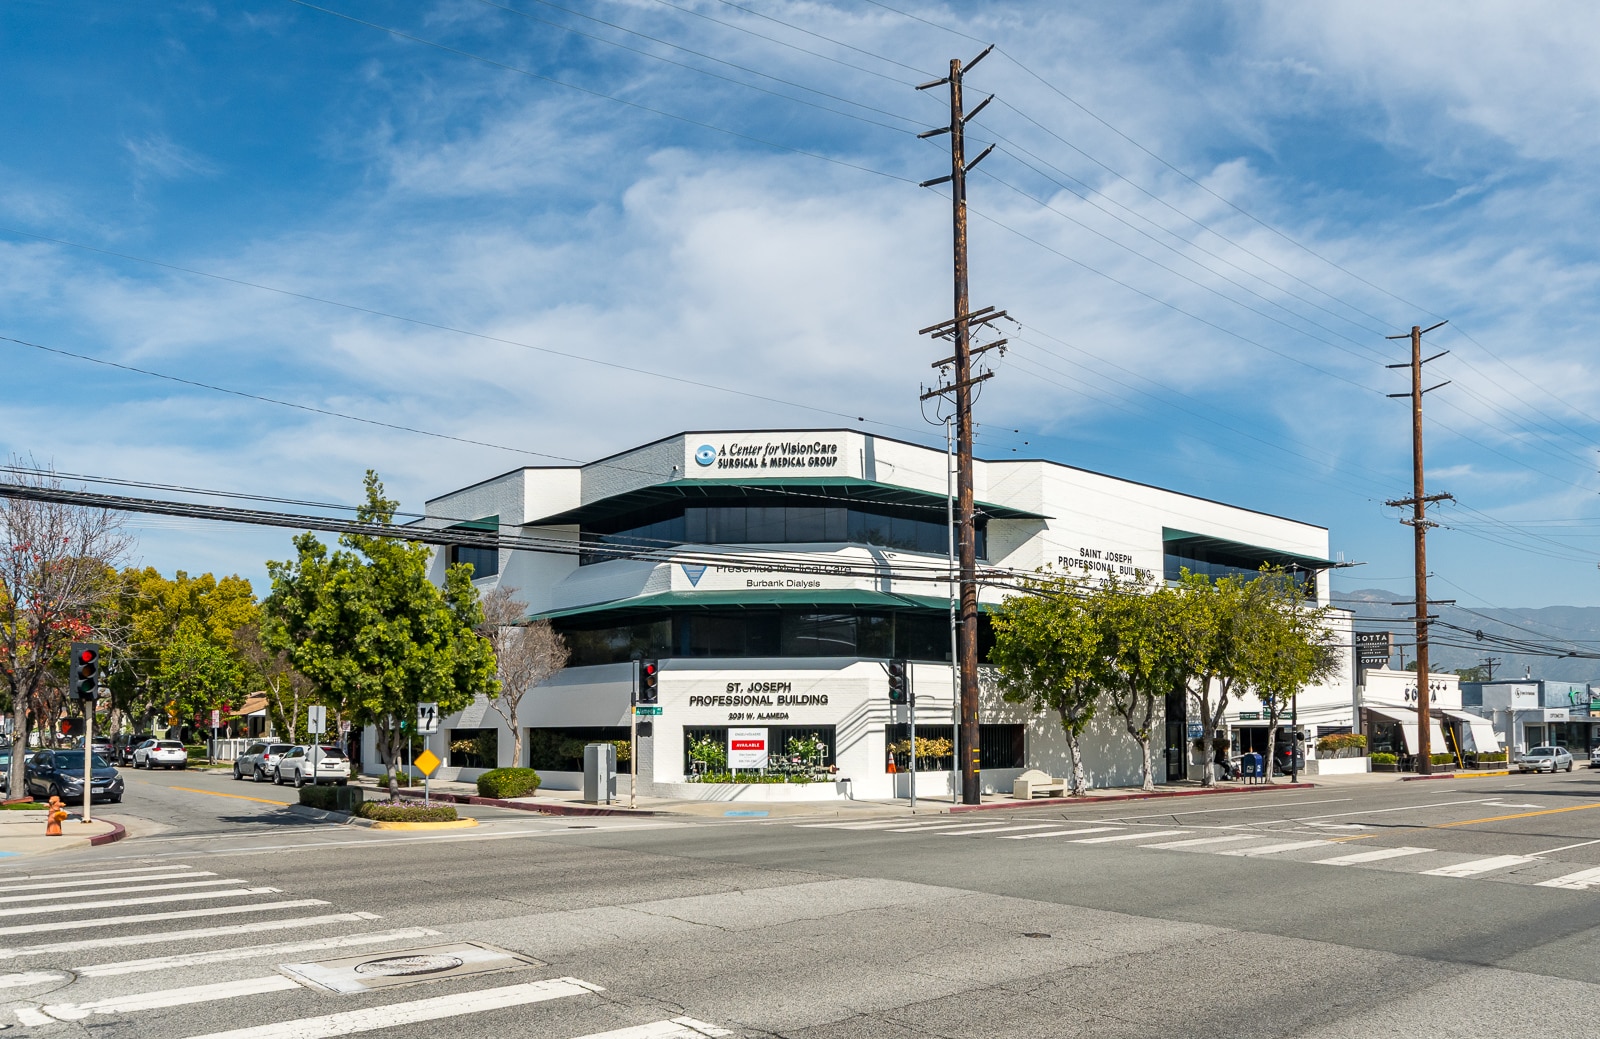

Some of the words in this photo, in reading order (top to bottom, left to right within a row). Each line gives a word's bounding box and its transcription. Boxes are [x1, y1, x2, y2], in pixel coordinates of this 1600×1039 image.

[718, 444, 726, 456] A
[730, 444, 762, 456] Center
[764, 442, 780, 458] for
[780, 442, 838, 455] VisionCare
[718, 458, 758, 468] SURGICAL
[761, 456, 768, 468] &
[770, 456, 806, 468] MEDICAL
[808, 456, 838, 467] GROUP
[1080, 548, 1102, 559] SAINT
[1105, 552, 1132, 564] JOSEPH
[1058, 556, 1116, 573] PROFESSIONAL
[1120, 566, 1151, 580] BUILNG
[787, 580, 820, 588] Dialysis
[747, 682, 792, 693] JOSEPH
[690, 696, 773, 706] PROFESSIONAL
[777, 695, 828, 705] BUILDING
[1404, 688, 1436, 702] SOA
